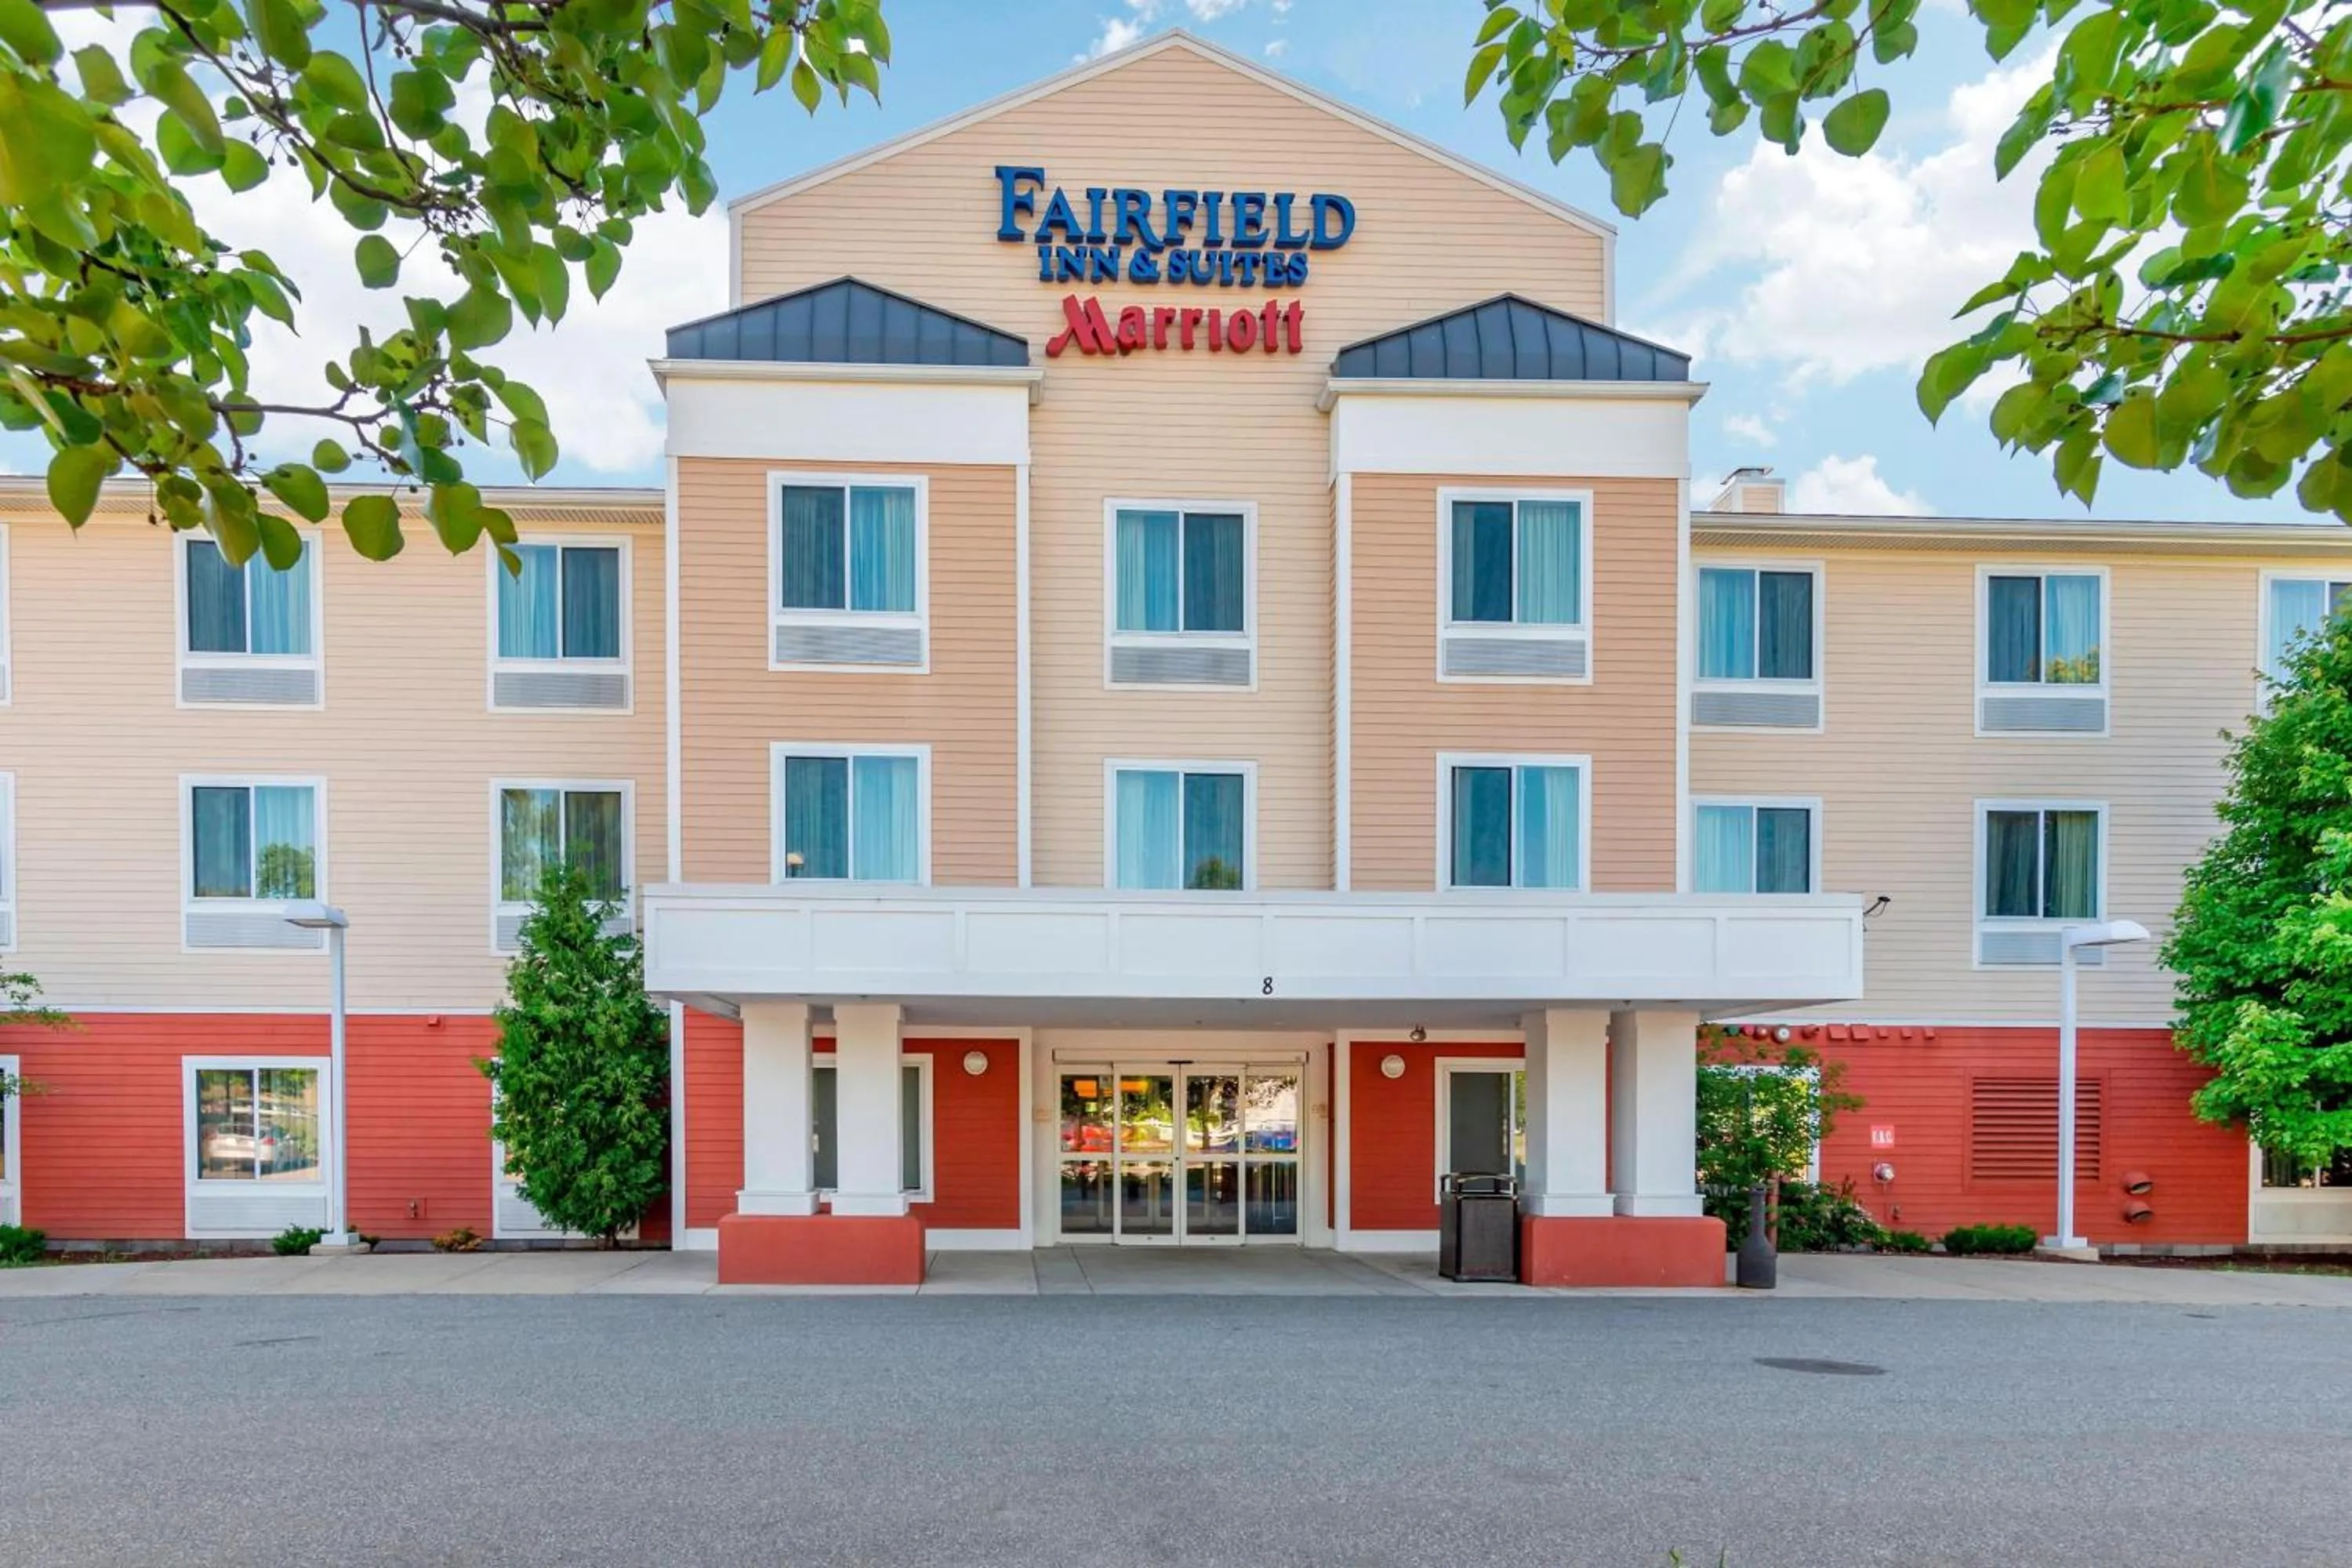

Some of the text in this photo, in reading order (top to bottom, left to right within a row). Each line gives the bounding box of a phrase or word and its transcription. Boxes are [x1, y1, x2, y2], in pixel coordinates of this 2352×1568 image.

[995, 165, 1356, 252] FAIRFIELD
[1038, 245, 1309, 288] INN & SUITES
[1045, 294, 1305, 358] Marriott
[1262, 976, 1273, 995] 8
